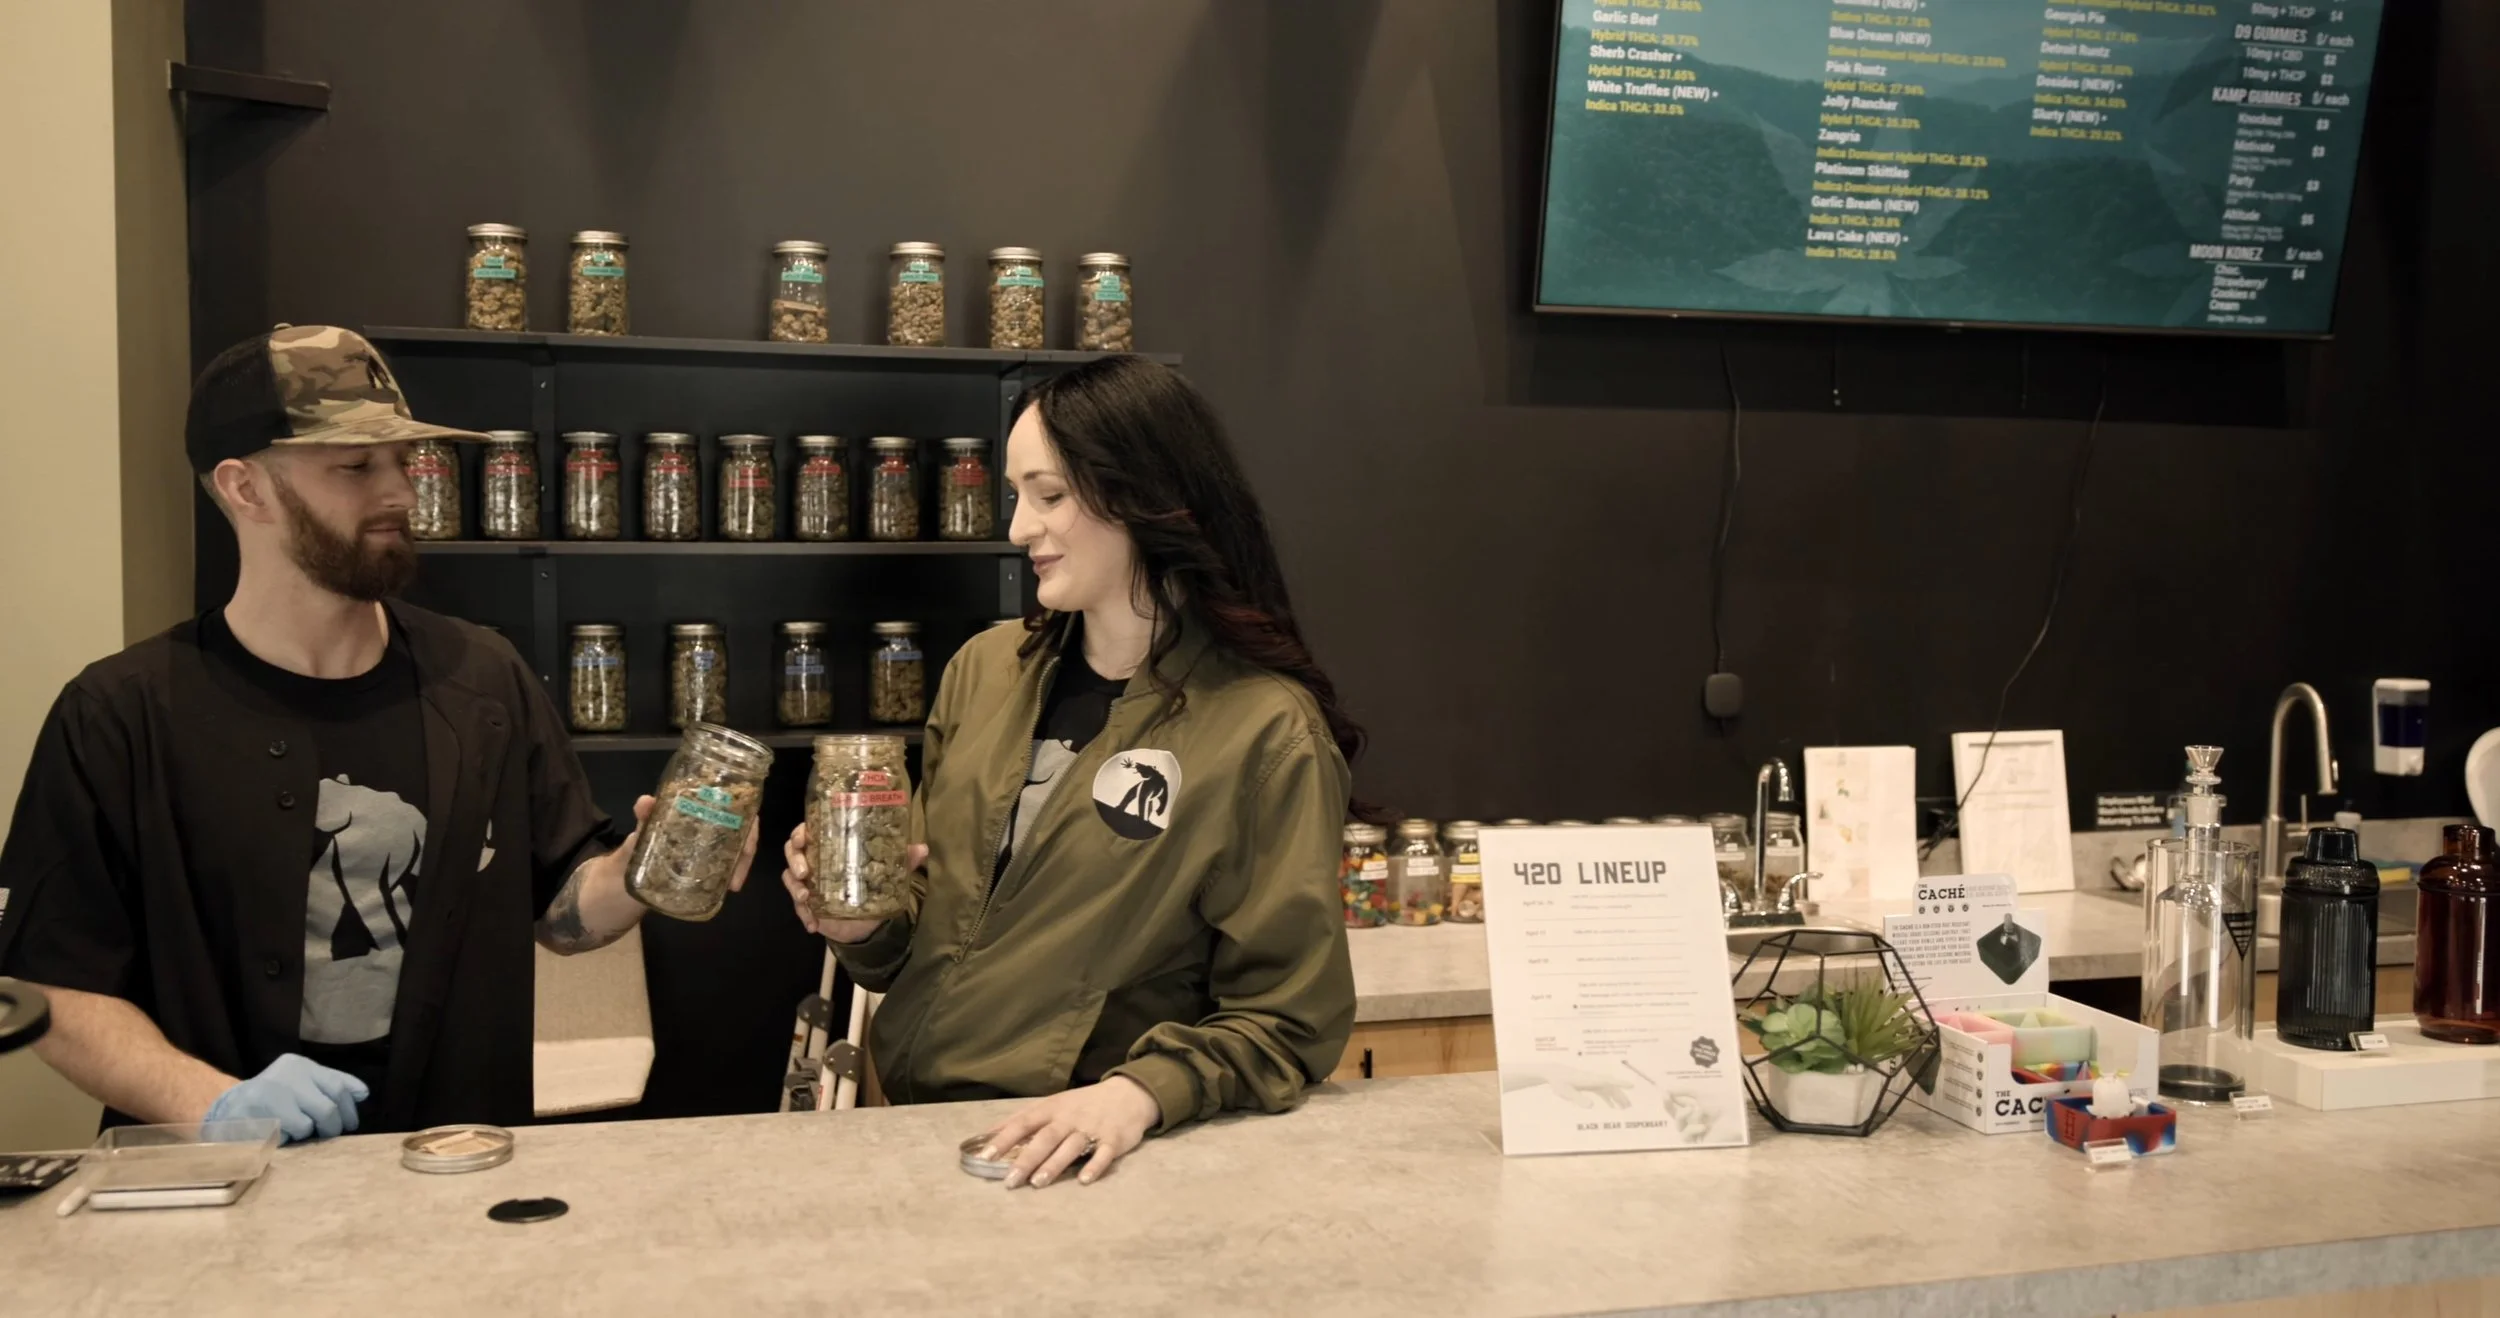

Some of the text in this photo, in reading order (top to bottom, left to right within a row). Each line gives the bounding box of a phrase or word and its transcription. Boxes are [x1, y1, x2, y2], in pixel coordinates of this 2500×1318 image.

[1592, 10, 1659, 26] Garlic Beef
[1591, 29, 1625, 43] Hybrid
[1829, 26, 1932, 47] Blue Dream (NEW)
[2253, 26, 2308, 44] GUMMIES
[2329, 36, 2354, 47] each
[1590, 45, 1673, 62] Sherb Crasher
[1588, 64, 1623, 78] Hybrid
[1624, 66, 1656, 79] THCA:
[1825, 60, 1852, 74] Pink
[1587, 80, 1711, 102] White Truffles (NEW)
[2211, 86, 2247, 102] KAMP
[2248, 89, 2303, 107] GUMMIES
[2325, 94, 2350, 106] each
[1585, 99, 1618, 112] Indica
[1619, 101, 1651, 114] THCA:
[1822, 95, 1899, 110] Jolly Rancher
[1814, 161, 1910, 179] Platinum Skittles
[2228, 173, 2255, 189] Party
[1811, 195, 1920, 214] Garlic Breath (NEW)
[1807, 228, 1901, 246] Lava Cake (NEW)
[2189, 243, 2225, 259] MOON
[2225, 245, 2264, 262] KONEZ
[2298, 249, 2324, 261] each
[869, 788, 904, 804] BREATH
[1513, 860, 1668, 886] 420 LINEUP
[1918, 884, 1965, 901] CACHÉ
[1995, 1096, 2046, 1116] CAC
